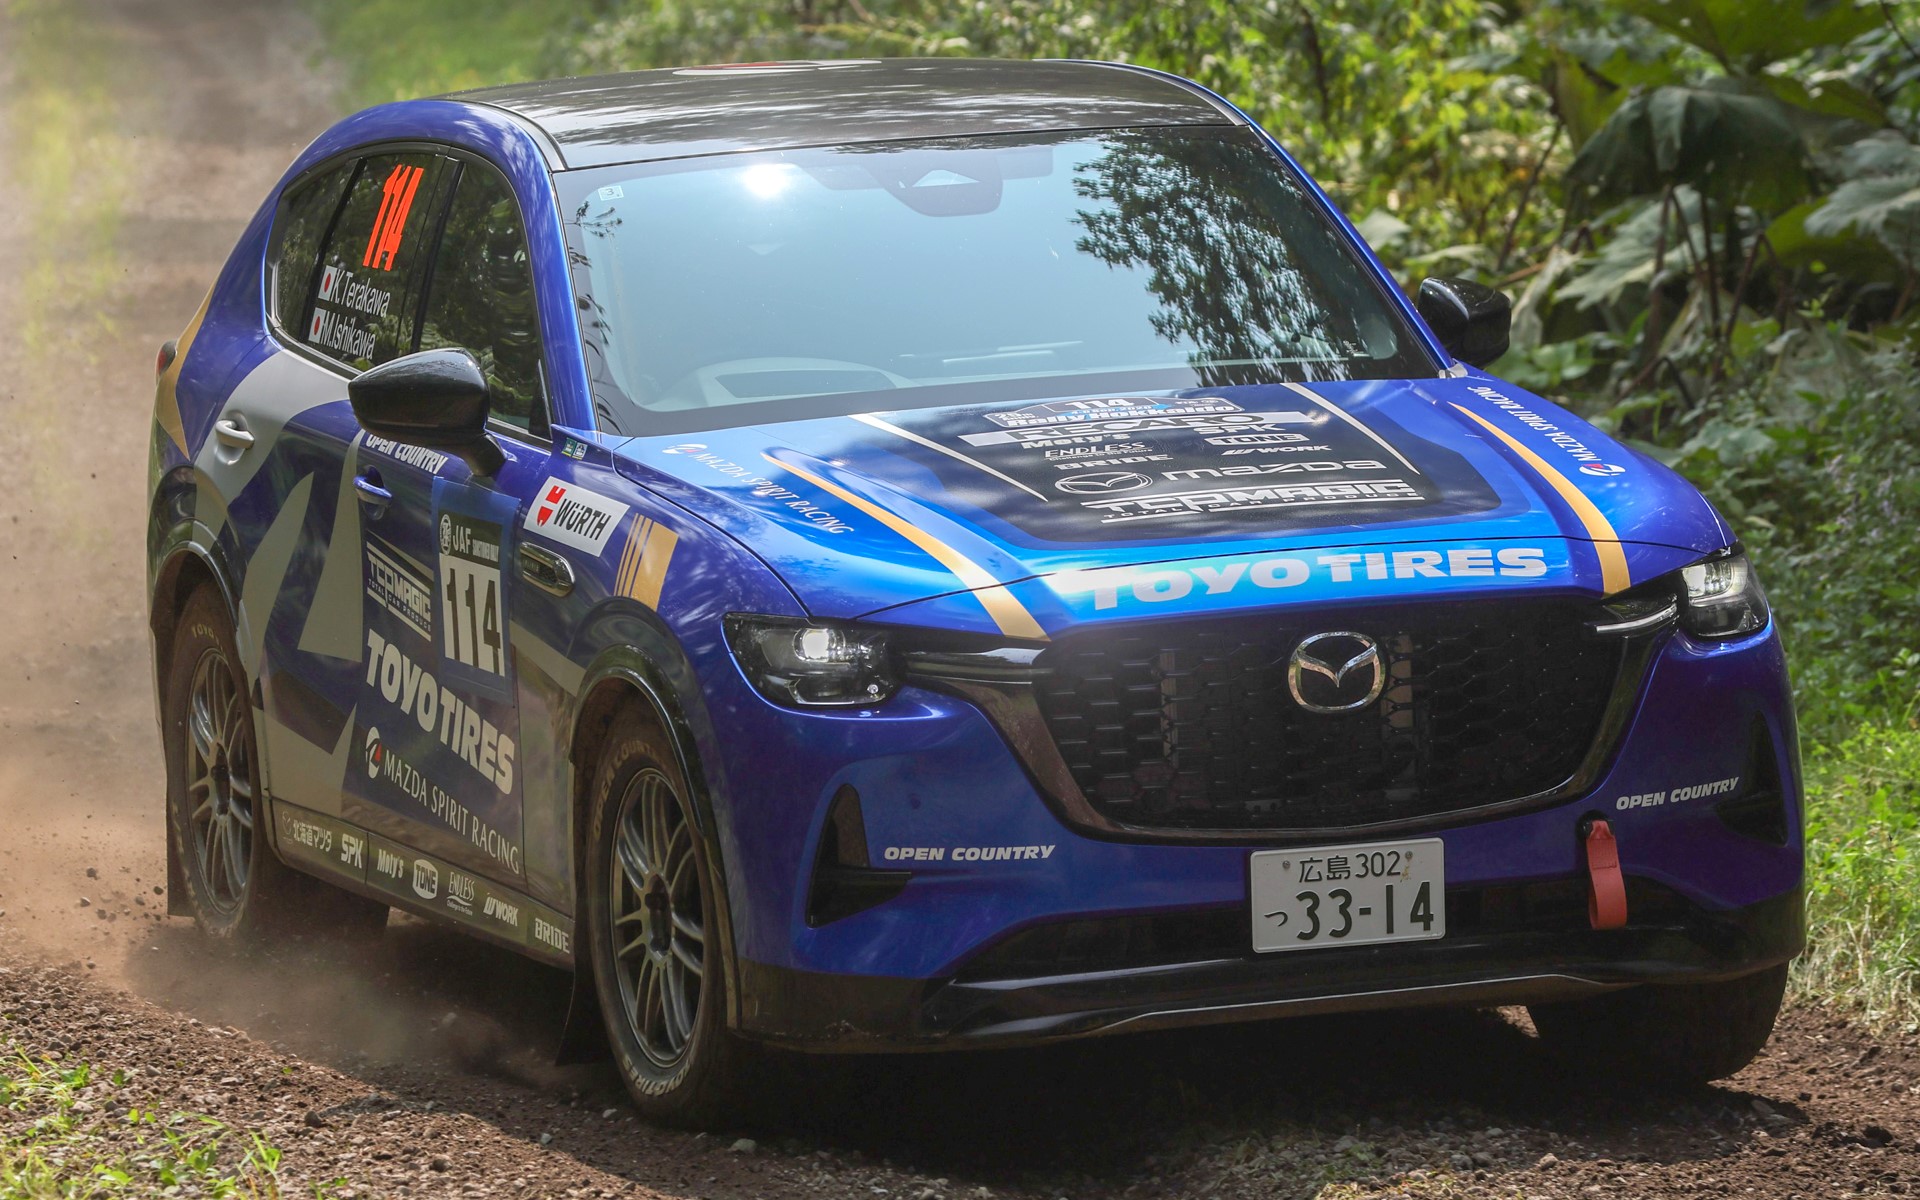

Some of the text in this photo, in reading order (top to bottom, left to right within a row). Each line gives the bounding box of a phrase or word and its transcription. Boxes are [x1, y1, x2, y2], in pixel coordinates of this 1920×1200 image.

[362, 164, 424, 272] 114
[330, 269, 391, 318] K.Terakawa
[320, 310, 376, 360] M.Ishikawa
[1007, 414, 1087, 427] Rally
[1089, 405, 1240, 419] Hokkaido
[1065, 399, 1135, 410] 114
[1006, 414, 1264, 440] RECARO
[1194, 424, 1286, 435] SPK
[1507, 410, 1558, 431] SPIRIT
[1021, 433, 1131, 449] Moty's
[1045, 441, 1146, 458] ENDLESS
[1212, 433, 1301, 444] TONE
[1253, 445, 1333, 455] WORK
[1545, 431, 1602, 461] MAZDA
[394, 443, 448, 475] COUNTRY
[1054, 454, 1174, 470] BRIDE
[690, 453, 855, 534] MAZDA SPIRIT RACING
[1104, 508, 1182, 518] TOTAL
[1282, 492, 1418, 503] PRODUCE
[553, 498, 612, 541] WÜRTH
[453, 525, 471, 554] JAF
[1317, 548, 1548, 583] TIRES
[368, 578, 385, 596] TOTAL
[446, 567, 502, 675] 114
[366, 628, 515, 795] TOYO TIRES
[1616, 777, 1739, 810] OPEN COUNTRY
[384, 749, 519, 874] MAZDA SPIRIT RACING
[341, 833, 363, 869] SPK
[377, 848, 404, 879] Moty's
[884, 845, 1055, 861] OPEN COUNTRY
[415, 865, 436, 894] TONE
[1299, 851, 1401, 883] 広島 302
[448, 871, 475, 901] ENDLESS
[495, 900, 519, 926] WORK
[1296, 881, 1434, 940] 33-14
[534, 917, 570, 954] BRIDE
